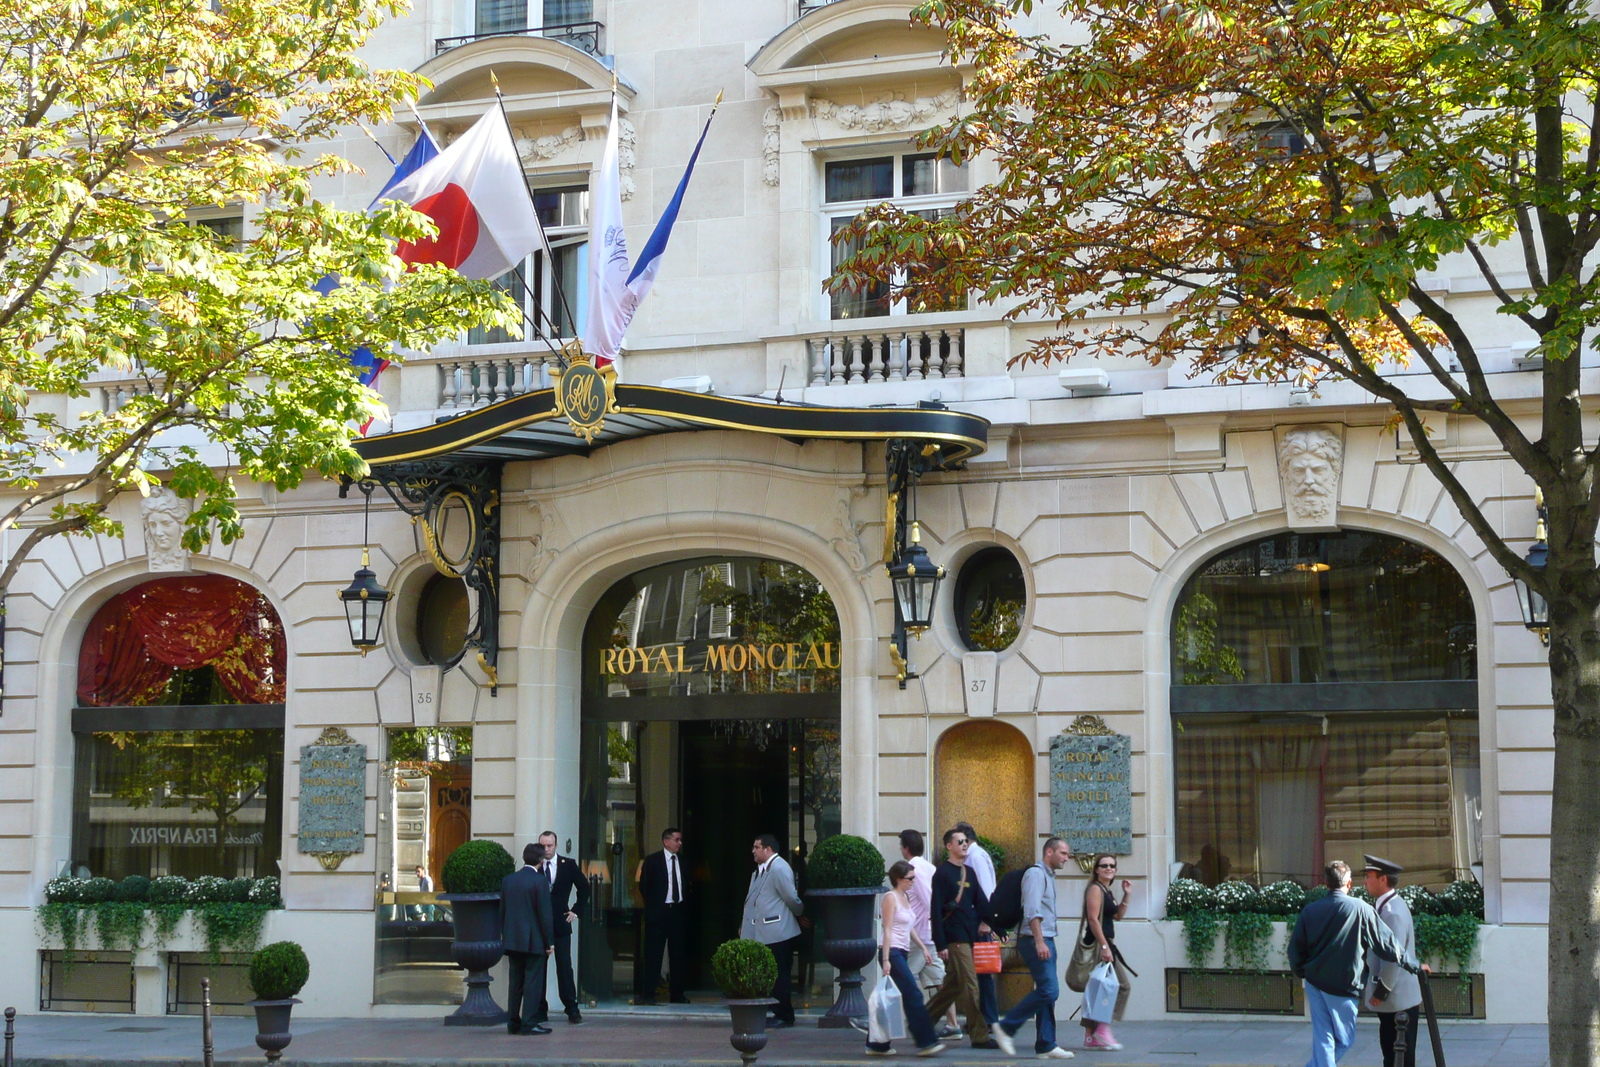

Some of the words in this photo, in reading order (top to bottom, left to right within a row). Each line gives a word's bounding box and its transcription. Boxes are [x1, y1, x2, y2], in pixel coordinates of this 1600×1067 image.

[600, 646, 693, 675] ROYAL
[705, 642, 842, 672] MONCEAU
[971, 679, 987, 692] 37
[417, 692, 433, 704] 36
[1065, 752, 1112, 763] ROYAL
[311, 760, 350, 769] ROYAL
[1056, 771, 1125, 782] MONCEAU
[304, 778, 359, 787] MONCEAU
[311, 796, 349, 805] HOTEL
[1066, 790, 1112, 802] HOTEL
[302, 830, 359, 838] RESTAURANT
[1057, 829, 1124, 839] RESTAURANT
